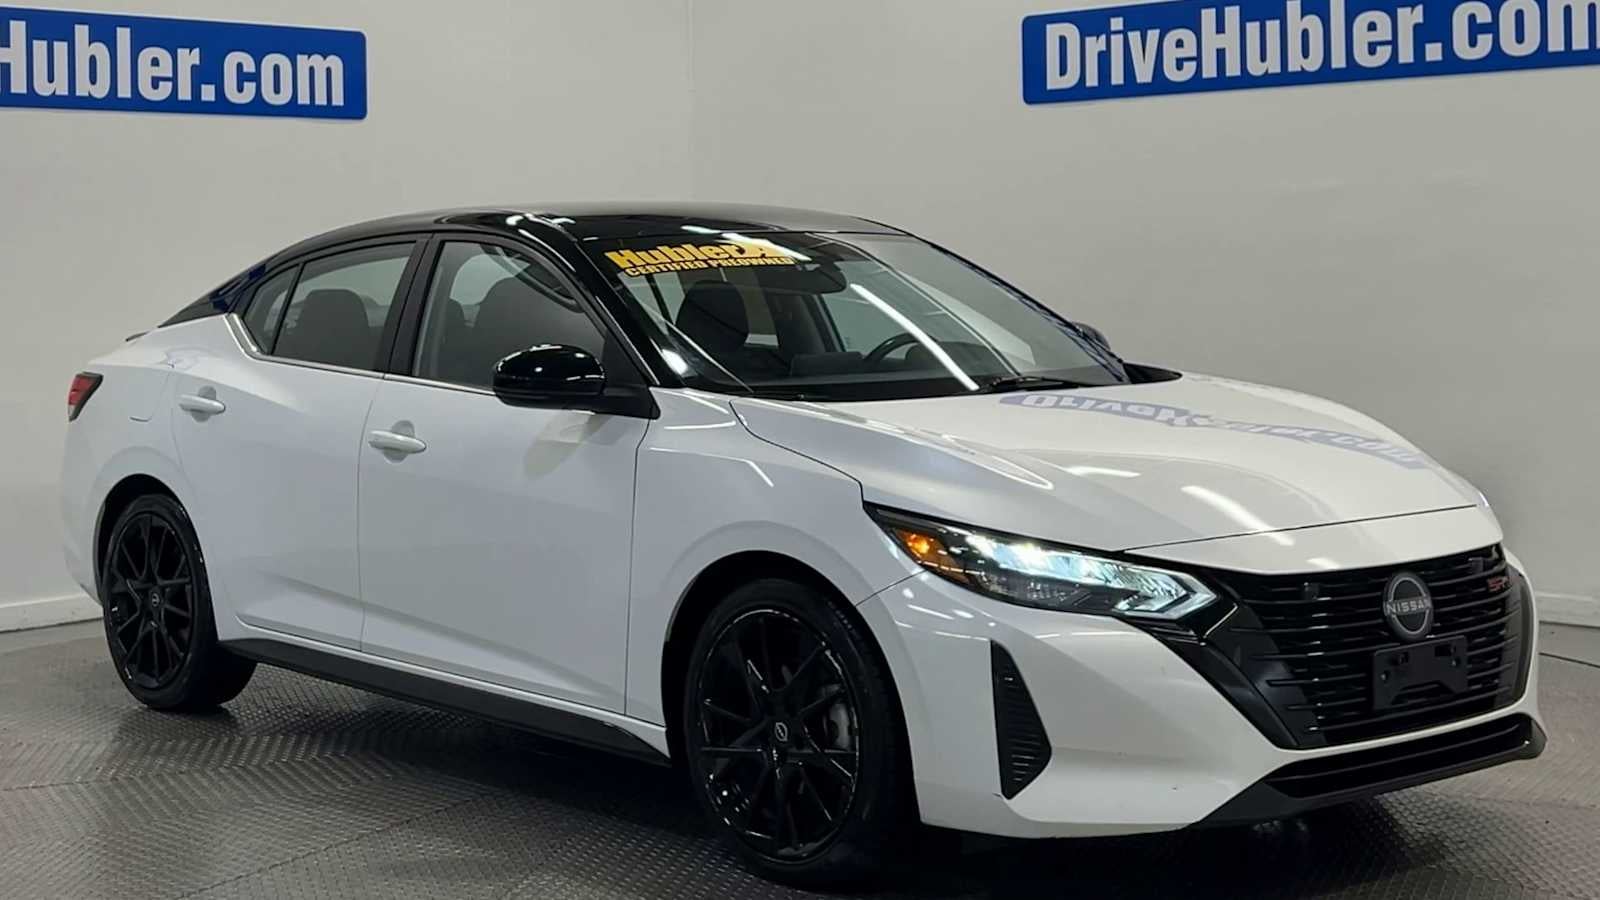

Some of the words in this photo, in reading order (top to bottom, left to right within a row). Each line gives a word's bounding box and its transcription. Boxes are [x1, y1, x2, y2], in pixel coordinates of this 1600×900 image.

[1045, 0, 1600, 90] DriveHubler.com
[605, 244, 740, 269] Hubler
[625, 260, 703, 277] CERTIFIED
[707, 256, 795, 268] PREOWNED
[1386, 598, 1430, 614] NISSAN
